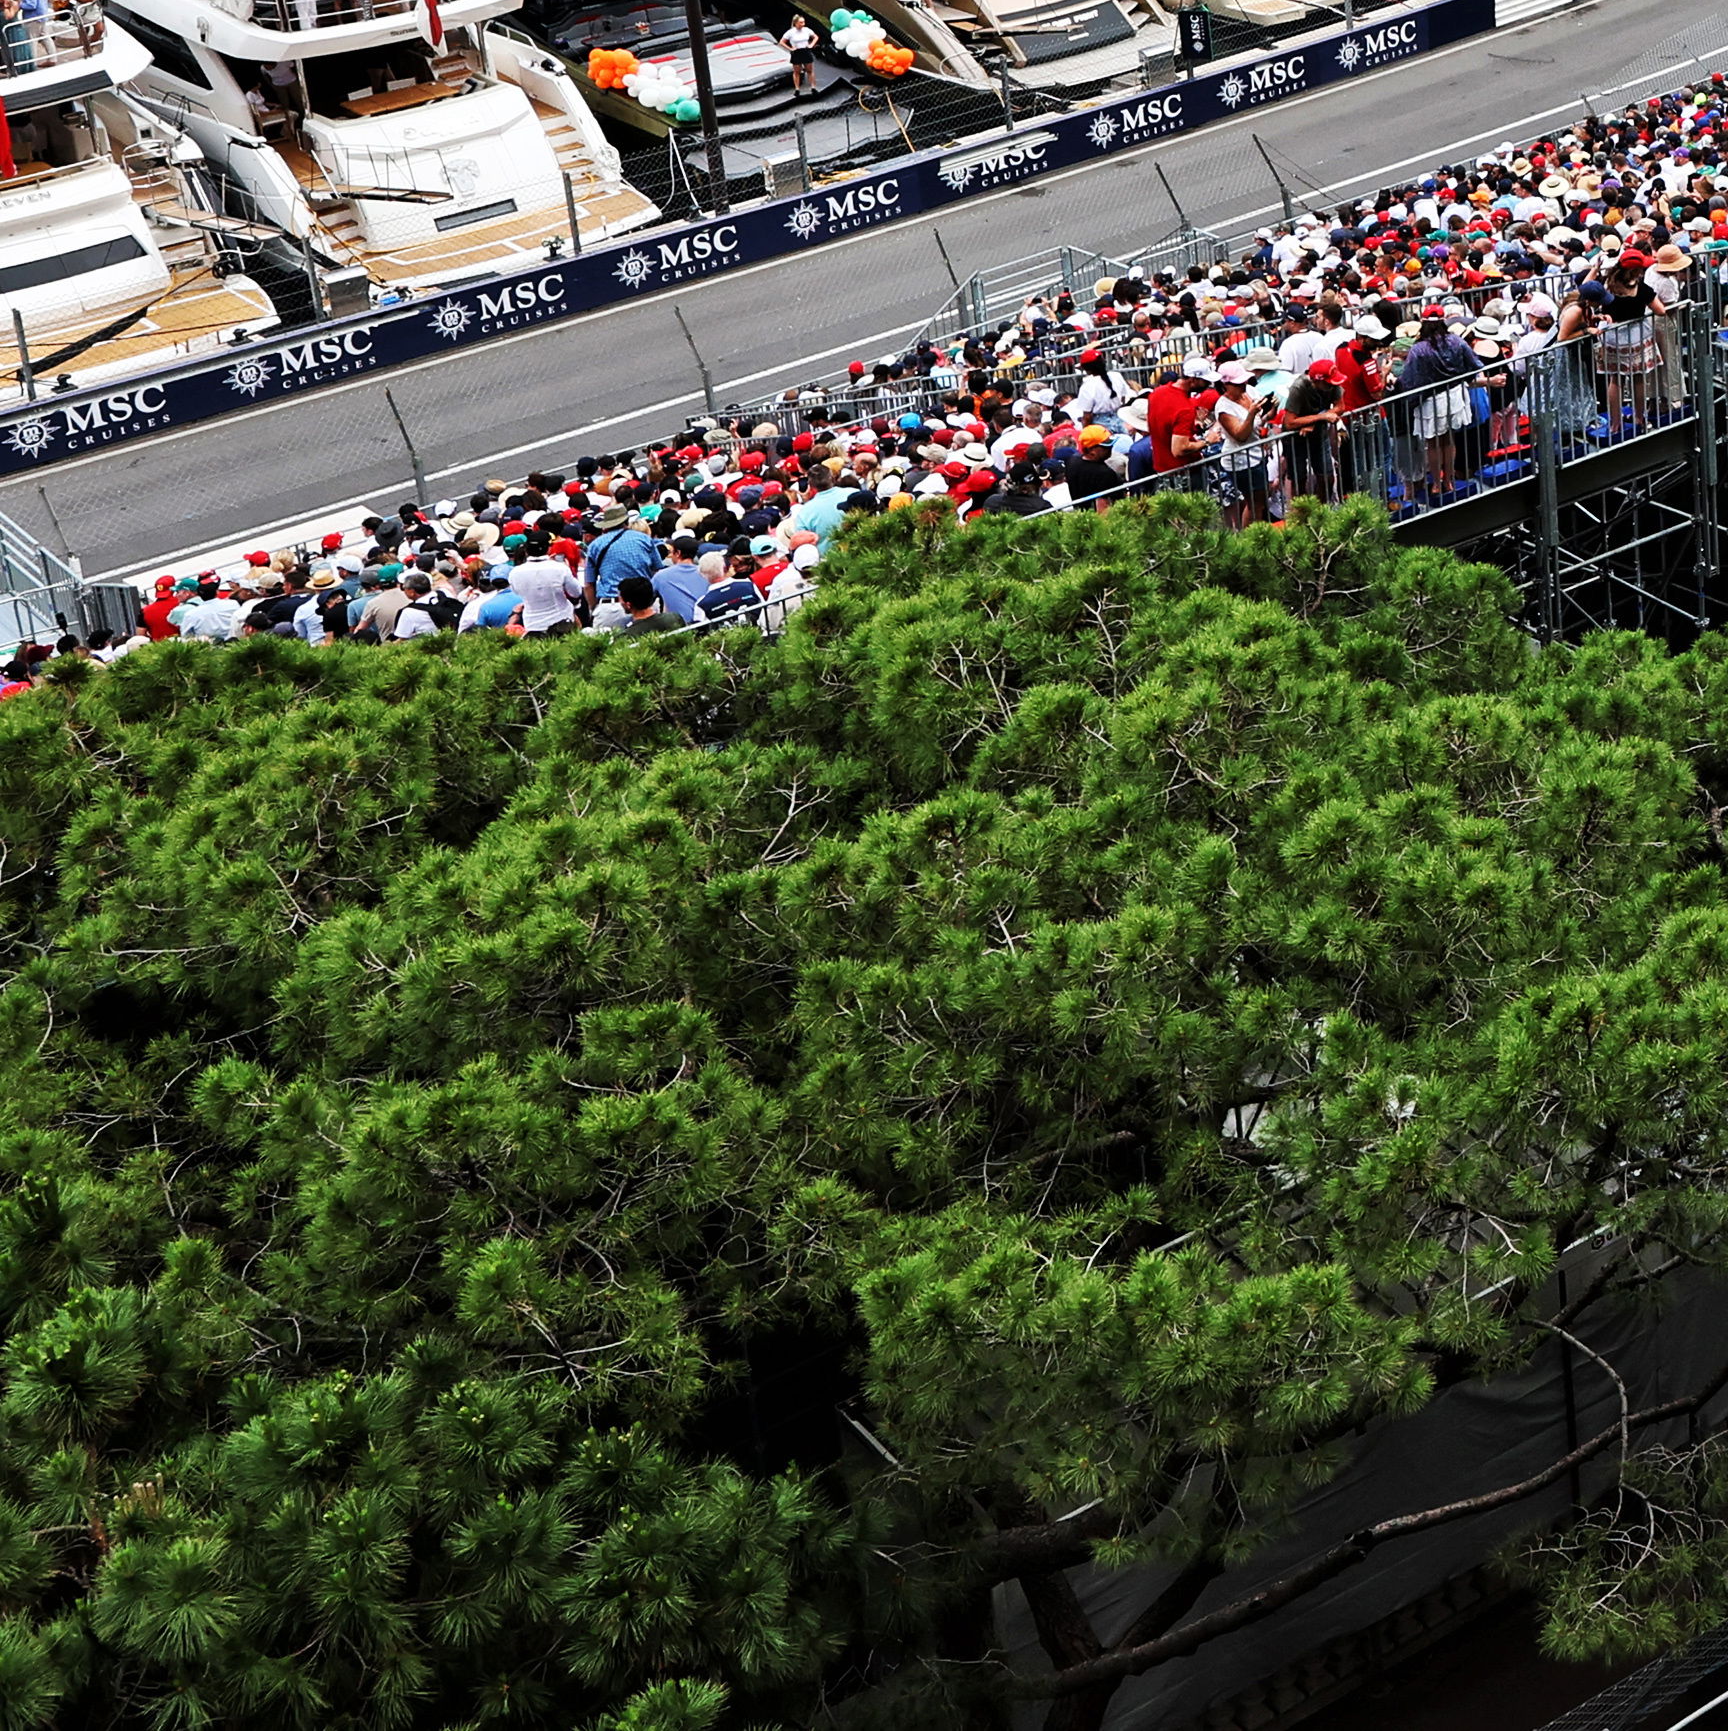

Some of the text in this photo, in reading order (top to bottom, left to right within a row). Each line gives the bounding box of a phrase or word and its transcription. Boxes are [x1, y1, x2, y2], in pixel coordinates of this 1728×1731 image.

[1190, 14, 1200, 40] MSC
[1364, 20, 1417, 56] MSC
[1366, 43, 1418, 68] CRUISES
[1248, 56, 1306, 92] MSC
[1250, 80, 1307, 104] CRUISES
[1120, 94, 1182, 132] MSC
[1122, 119, 1184, 144] CRUISES
[981, 160, 1048, 188] CRUISES
[0, 191, 51, 209] EVEN
[825, 178, 900, 222] MSC
[828, 205, 902, 235] CRUISES
[657, 225, 739, 270] MSC
[660, 251, 741, 283] CRUISES
[477, 273, 565, 321] MSC
[480, 301, 568, 334] CRUISES
[277, 326, 373, 376] MSC
[60, 383, 166, 436] MSC
[68, 413, 171, 449] CRUISES
